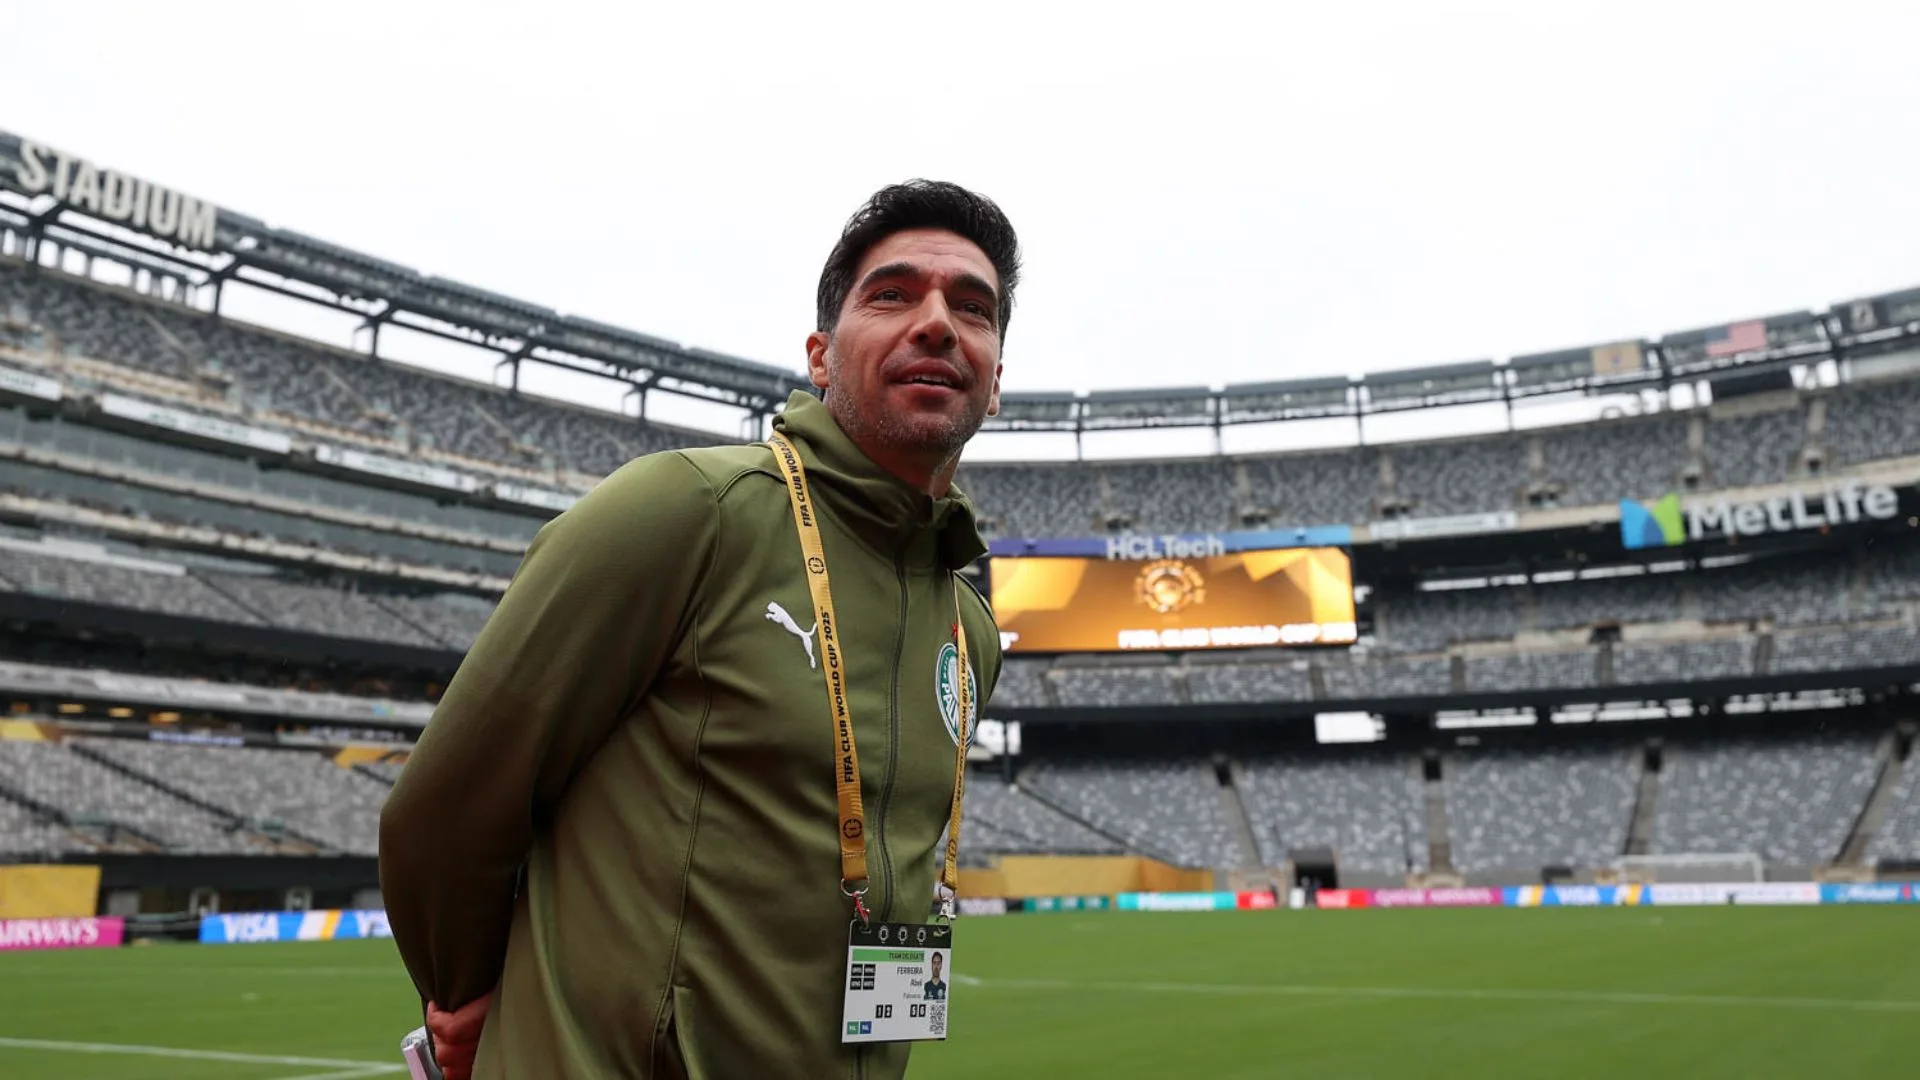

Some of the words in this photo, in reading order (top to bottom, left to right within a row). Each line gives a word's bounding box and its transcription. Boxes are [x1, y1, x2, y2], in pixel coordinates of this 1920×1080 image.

[17, 138, 217, 248] STADIUM
[792, 475, 806, 502] CLUB
[800, 503, 812, 527] FIFA
[1688, 482, 1899, 540] MetLife
[1106, 534, 1224, 560] HCLTech
[822, 611, 833, 641] 2025
[827, 644, 838, 669] CUP
[831, 671, 845, 717] WORLD
[839, 720, 850, 753] CLUB
[844, 755, 855, 782] FIFA
[222, 912, 279, 942] VISA
[896, 966, 923, 975] FERREIRA
